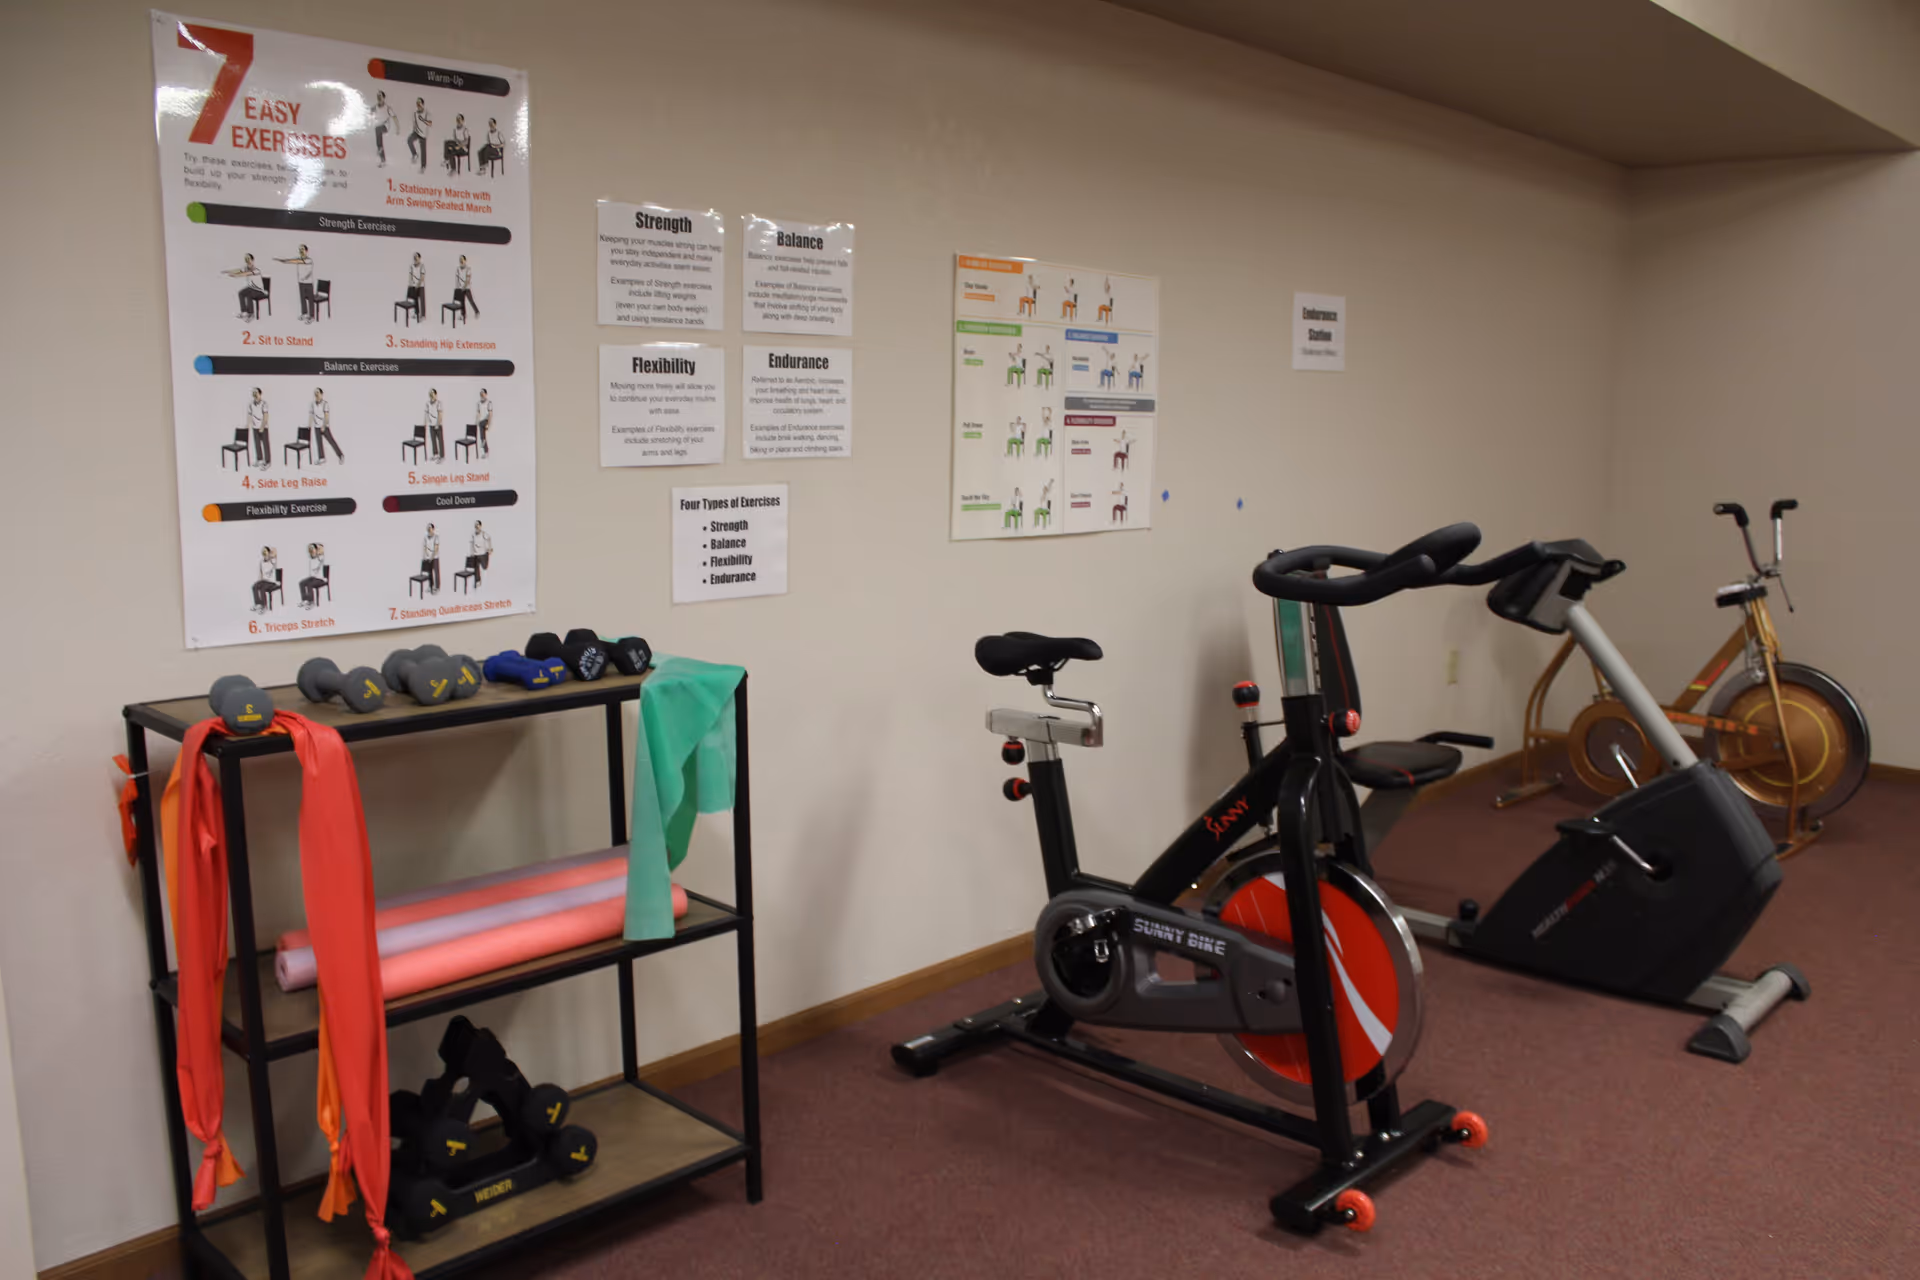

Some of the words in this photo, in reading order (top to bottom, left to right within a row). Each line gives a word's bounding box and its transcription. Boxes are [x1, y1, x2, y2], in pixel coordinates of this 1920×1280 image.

[178, 23, 253, 144] 7
[427, 71, 464, 87] Warm-Up
[244, 96, 301, 125] EASY
[232, 126, 347, 160] EXERCISES
[184, 152, 198, 164] Try
[202, 156, 226, 165] these
[231, 160, 273, 170] exercises
[184, 166, 205, 176] build
[227, 172, 247, 180] your
[252, 173, 286, 184] strength
[387, 178, 397, 192] 1.
[399, 183, 442, 198] Stationary
[444, 187, 471, 199] March
[473, 191, 491, 201] with
[386, 195, 404, 205] Arm
[406, 197, 465, 212] Swing/Seated
[466, 202, 492, 214] March
[319, 216, 356, 230] Strength
[357, 219, 397, 232] Exercises
[635, 211, 692, 234] Strength
[777, 231, 824, 250] Balance
[242, 330, 256, 345] 2.
[258, 335, 272, 345] Sit
[274, 336, 284, 345] to
[286, 336, 313, 346] Stand
[386, 334, 398, 348] 3.
[400, 338, 438, 350] Standing
[440, 339, 454, 350] Hip
[456, 340, 496, 350] Extension
[324, 361, 358, 371] Balance
[359, 362, 399, 372] Exercises
[632, 356, 696, 376] Flexibility
[768, 352, 829, 369] Endurance
[241, 475, 255, 489] 4.
[257, 479, 279, 489] Side
[281, 479, 299, 490] Leg
[301, 477, 328, 487] Raise
[408, 471, 420, 485] 5.
[422, 474, 448, 486] Single
[450, 473, 465, 484] Leg
[466, 472, 490, 482] Stand
[246, 505, 288, 515] Flexibility
[290, 503, 328, 513] Exercise
[436, 496, 453, 506] Cool
[454, 495, 476, 505] Down
[680, 499, 700, 511] Four
[702, 498, 729, 511] Types
[730, 497, 739, 508] of
[740, 496, 780, 508] Exercises
[710, 519, 749, 532] Strength
[710, 538, 747, 550] Balance
[710, 554, 753, 567] Flexibility
[710, 571, 756, 585] Endurance
[388, 607, 399, 620] 7.
[400, 608, 437, 620] Standing
[439, 603, 482, 615] Quadriceps
[484, 599, 512, 610] Stretch
[248, 620, 262, 634] 6.
[264, 622, 299, 632] Triceps
[301, 617, 335, 629] Stretch
[1203, 796, 1249, 842] SUNNY
[1133, 918, 1185, 945] SUNNY
[1188, 932, 1227, 956] BIKE
[474, 1178, 513, 1203] WEIDER
